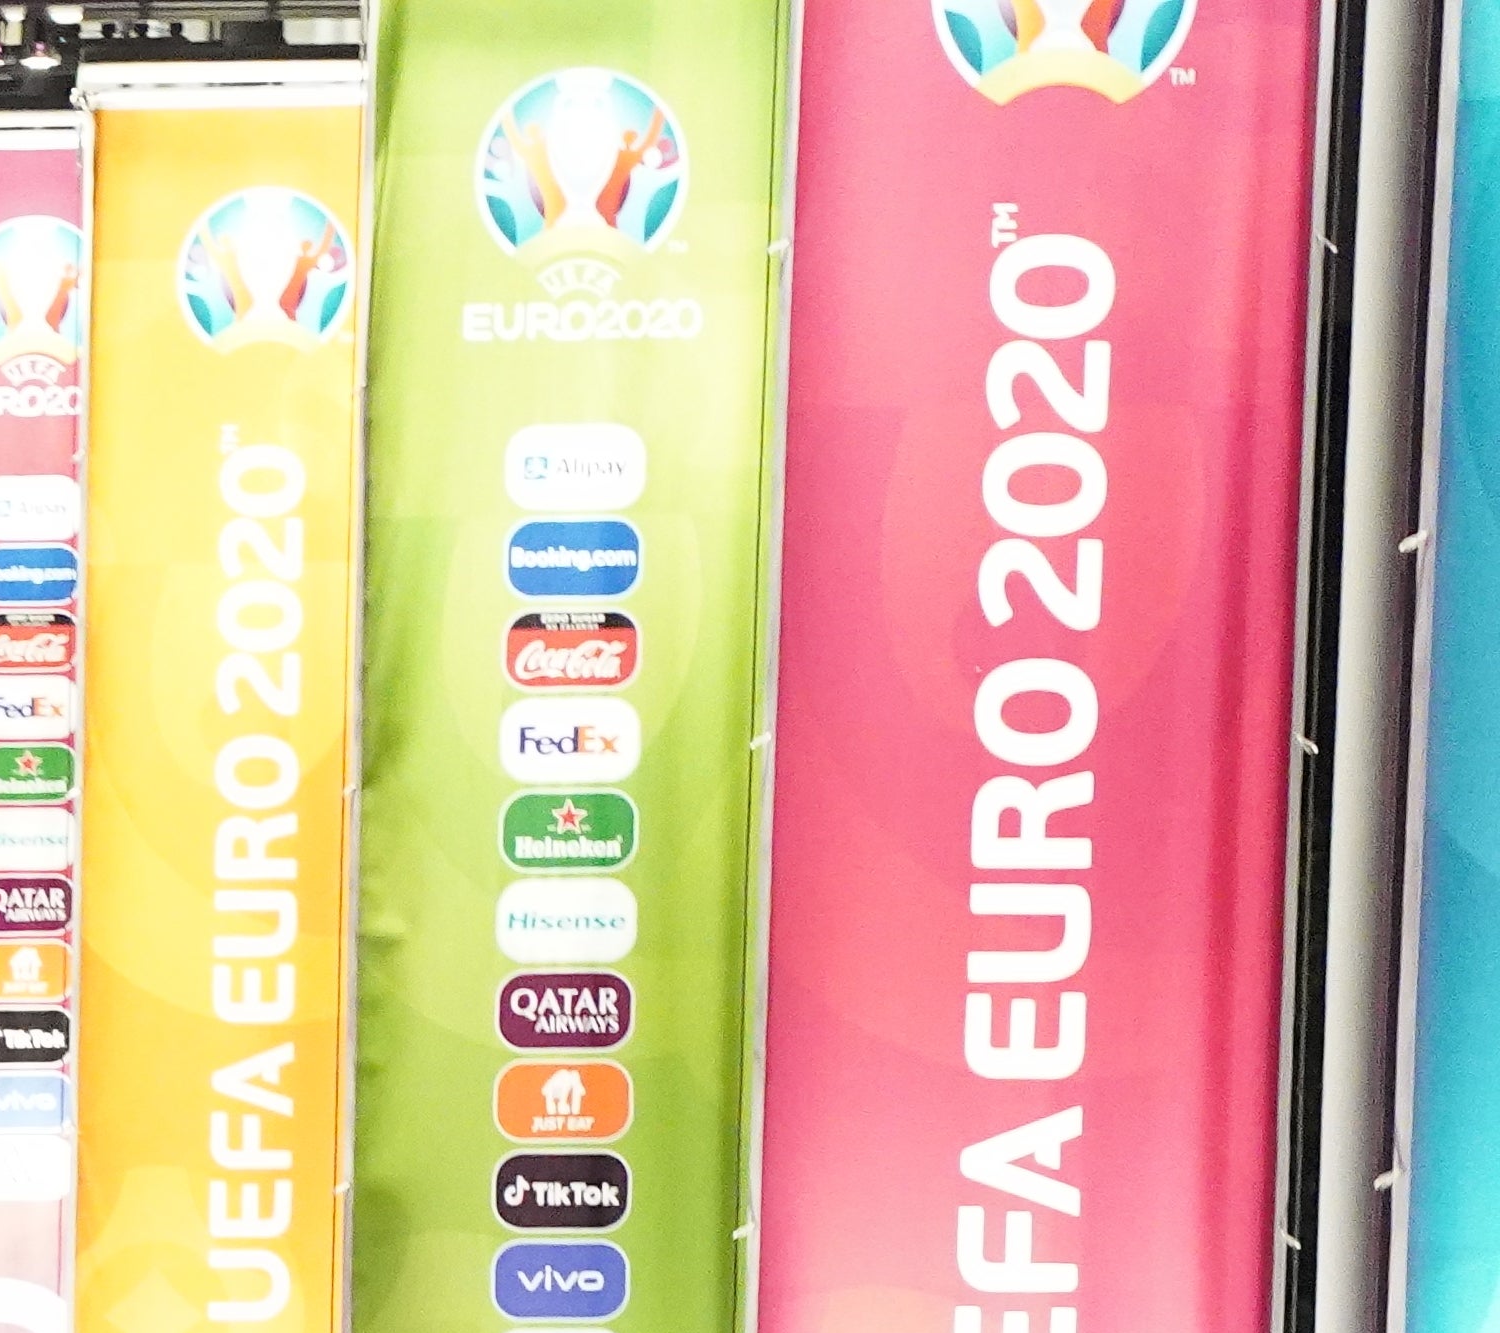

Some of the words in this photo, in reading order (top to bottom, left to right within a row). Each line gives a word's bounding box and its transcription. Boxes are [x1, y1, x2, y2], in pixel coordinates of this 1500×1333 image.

[461, 298, 704, 342] EURO2020
[977, 233, 1117, 632] 2020
[511, 545, 638, 572] Booking.com
[214, 444, 304, 717] 2020
[519, 725, 619, 754] FedEx
[514, 834, 624, 859] Heineken
[212, 733, 303, 1026] EURO
[962, 657, 1100, 1081] EURO
[508, 912, 626, 930] Hisense
[510, 987, 619, 1021] QATAR
[3, 1028, 68, 1050] TikTok
[534, 1014, 620, 1034] AIRWAYS
[206, 1043, 296, 1323] UEFA
[531, 1181, 621, 1207] TikTok
[516, 1263, 605, 1293] vivo
